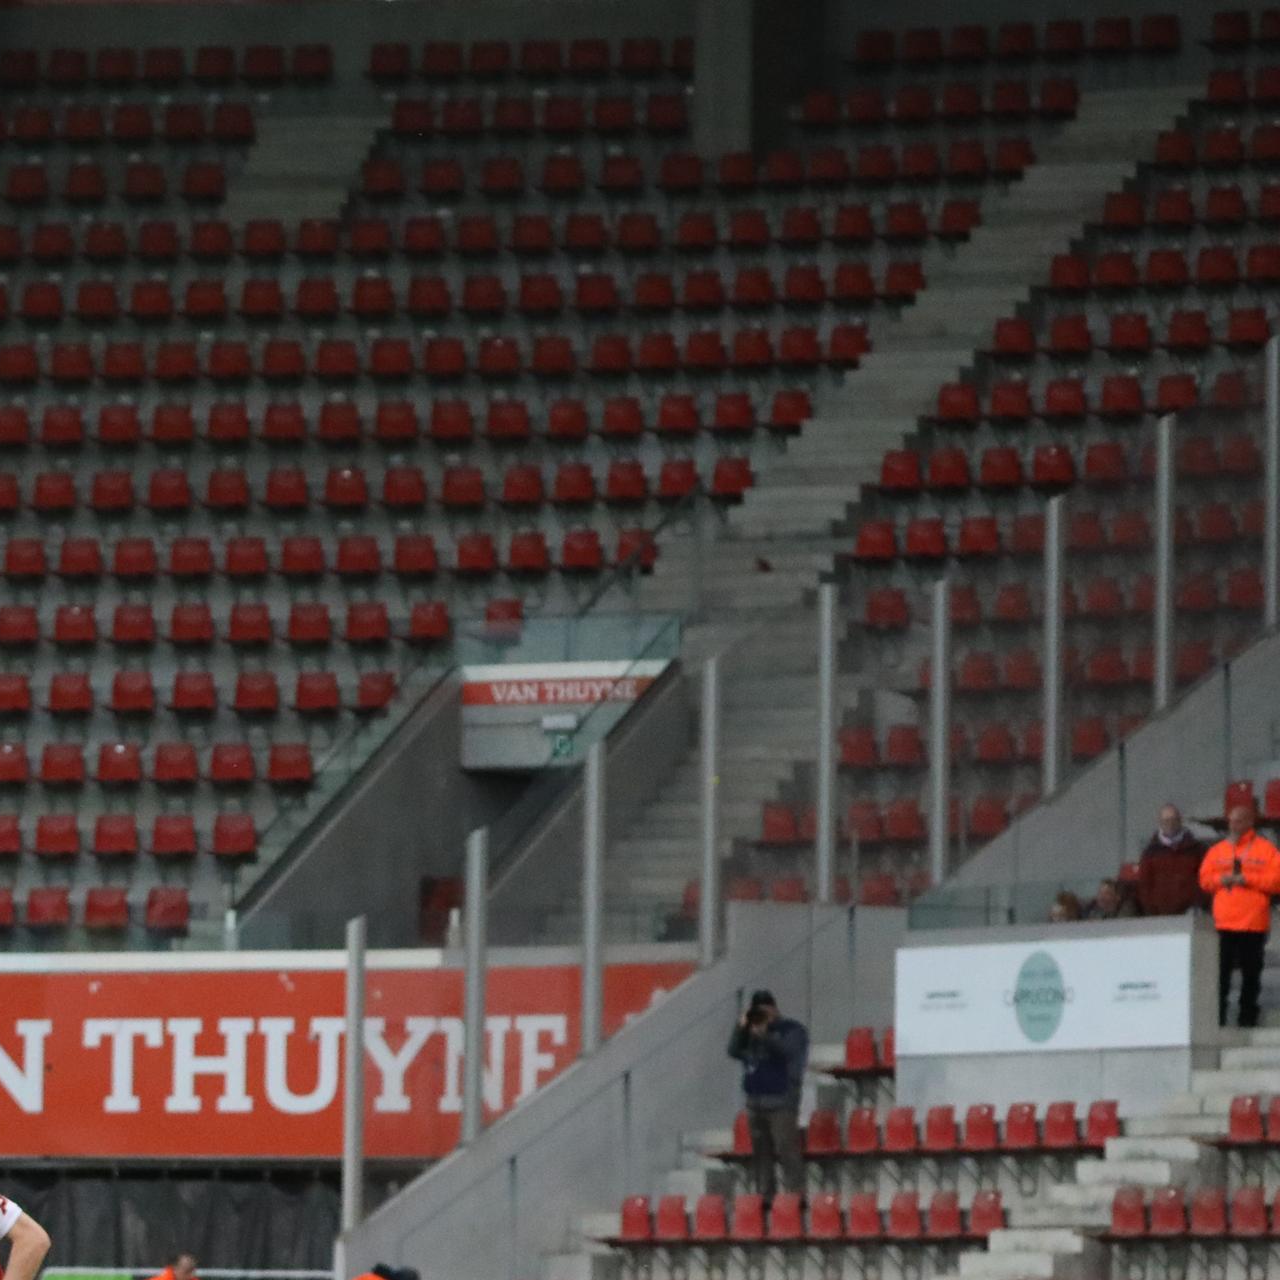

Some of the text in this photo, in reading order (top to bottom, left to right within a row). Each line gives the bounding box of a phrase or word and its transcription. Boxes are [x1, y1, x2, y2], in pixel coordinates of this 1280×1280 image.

[492, 679, 637, 702] VAN THUYNE
[81, 1014, 568, 1114] THUYNE
